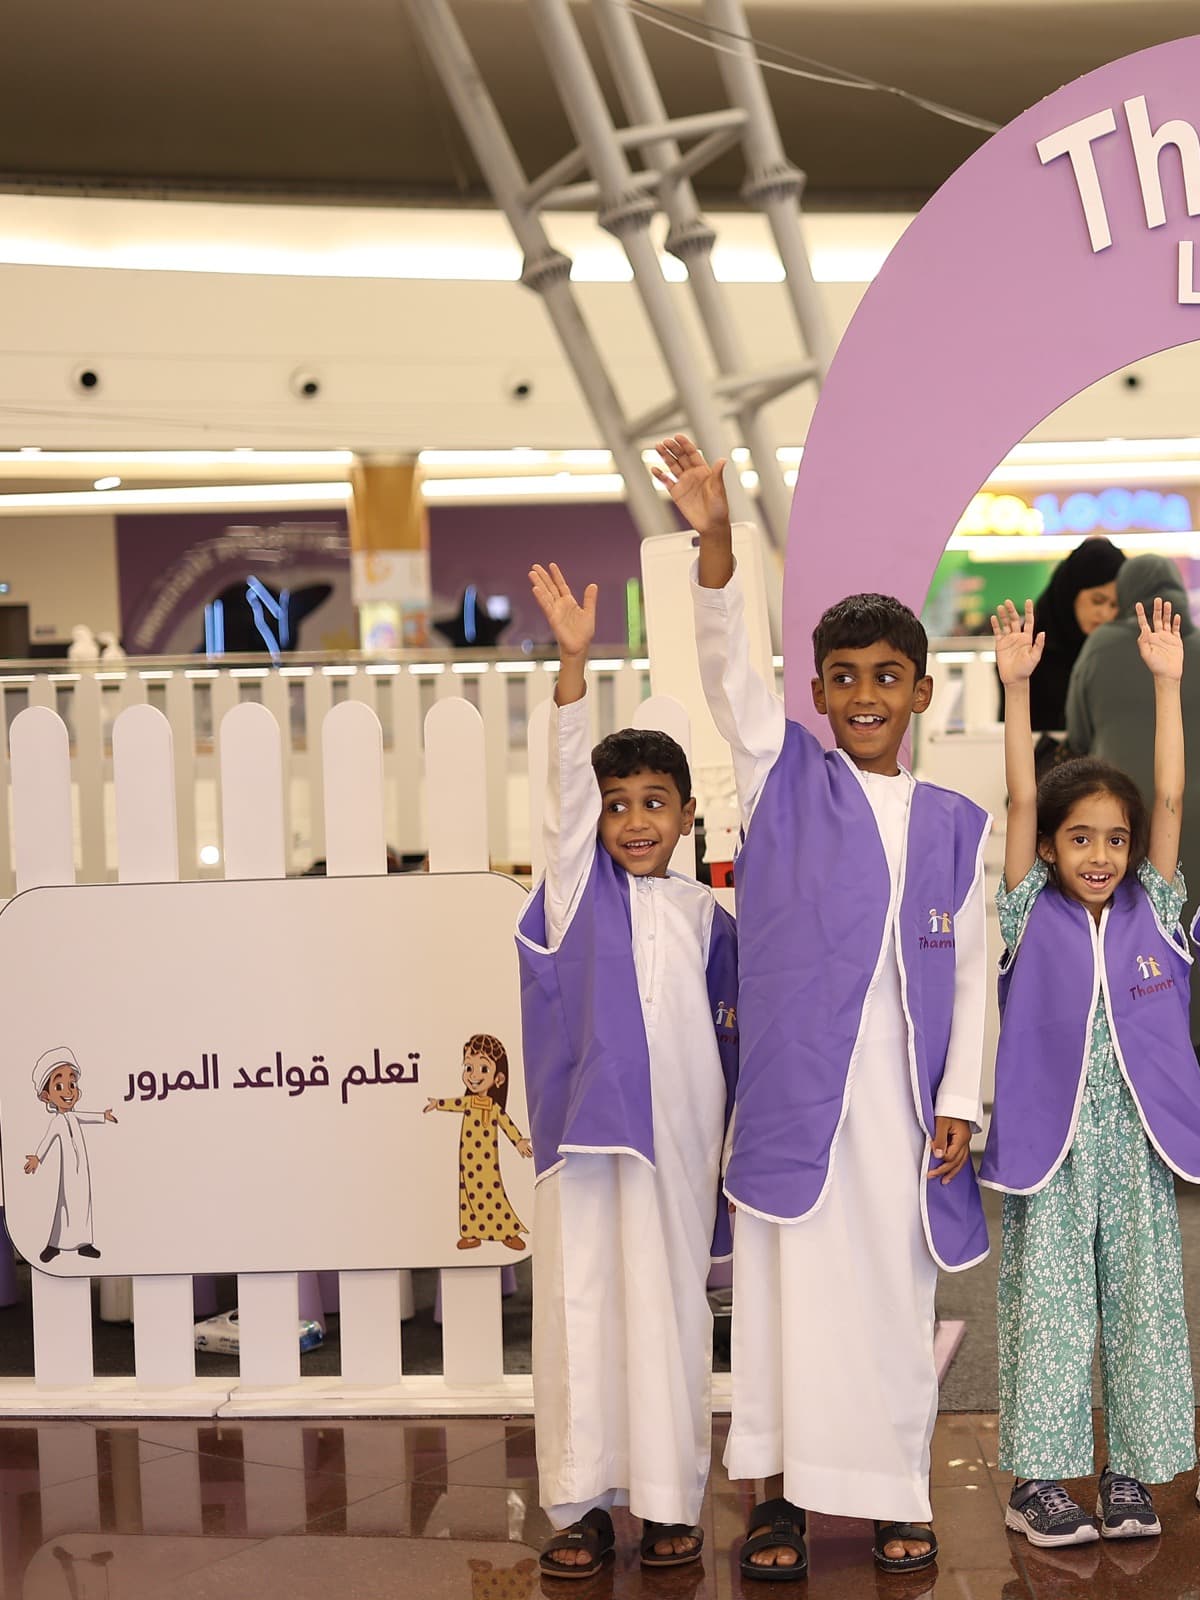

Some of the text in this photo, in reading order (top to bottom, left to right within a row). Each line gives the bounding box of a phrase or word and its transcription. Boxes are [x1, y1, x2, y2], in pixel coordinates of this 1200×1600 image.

[123, 1048, 421, 1105] تعلم قواعد المرور
